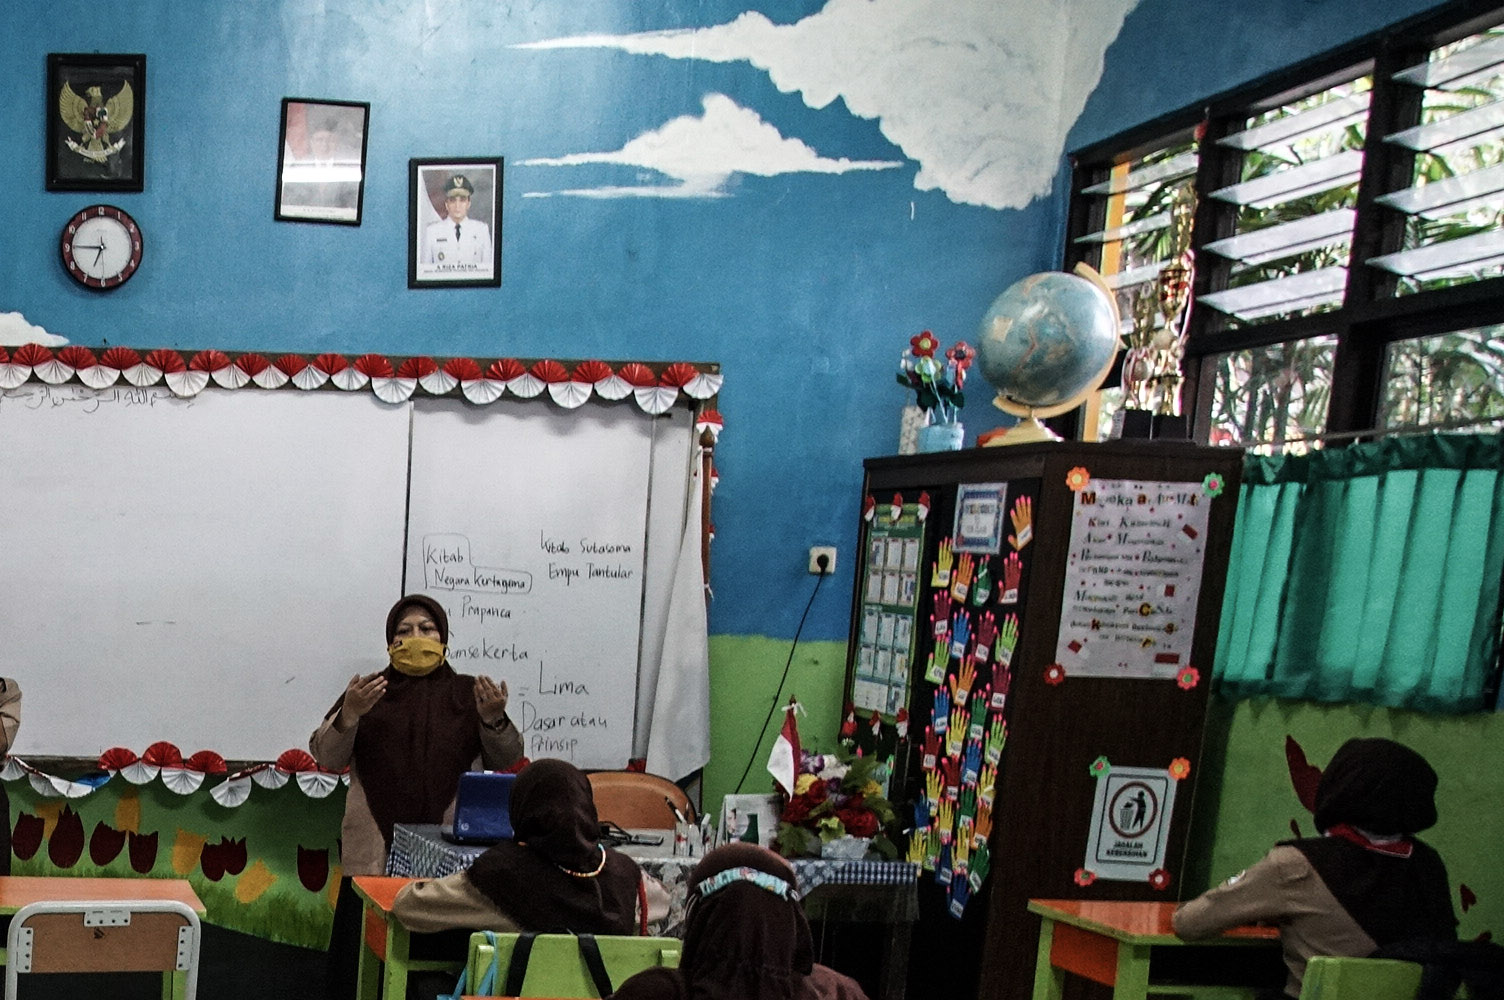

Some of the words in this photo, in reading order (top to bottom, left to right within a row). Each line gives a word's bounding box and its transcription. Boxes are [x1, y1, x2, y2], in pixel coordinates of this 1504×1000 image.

[426, 543, 464, 565] Kitab
[580, 537, 631, 554] Sutasoma
[548, 561, 579, 586] Empu
[585, 562, 634, 580] Tantular
[538, 660, 590, 696] Lima
[522, 700, 566, 734] Dasar
[570, 711, 608, 728] atau
[531, 733, 578, 761] Prinsip
